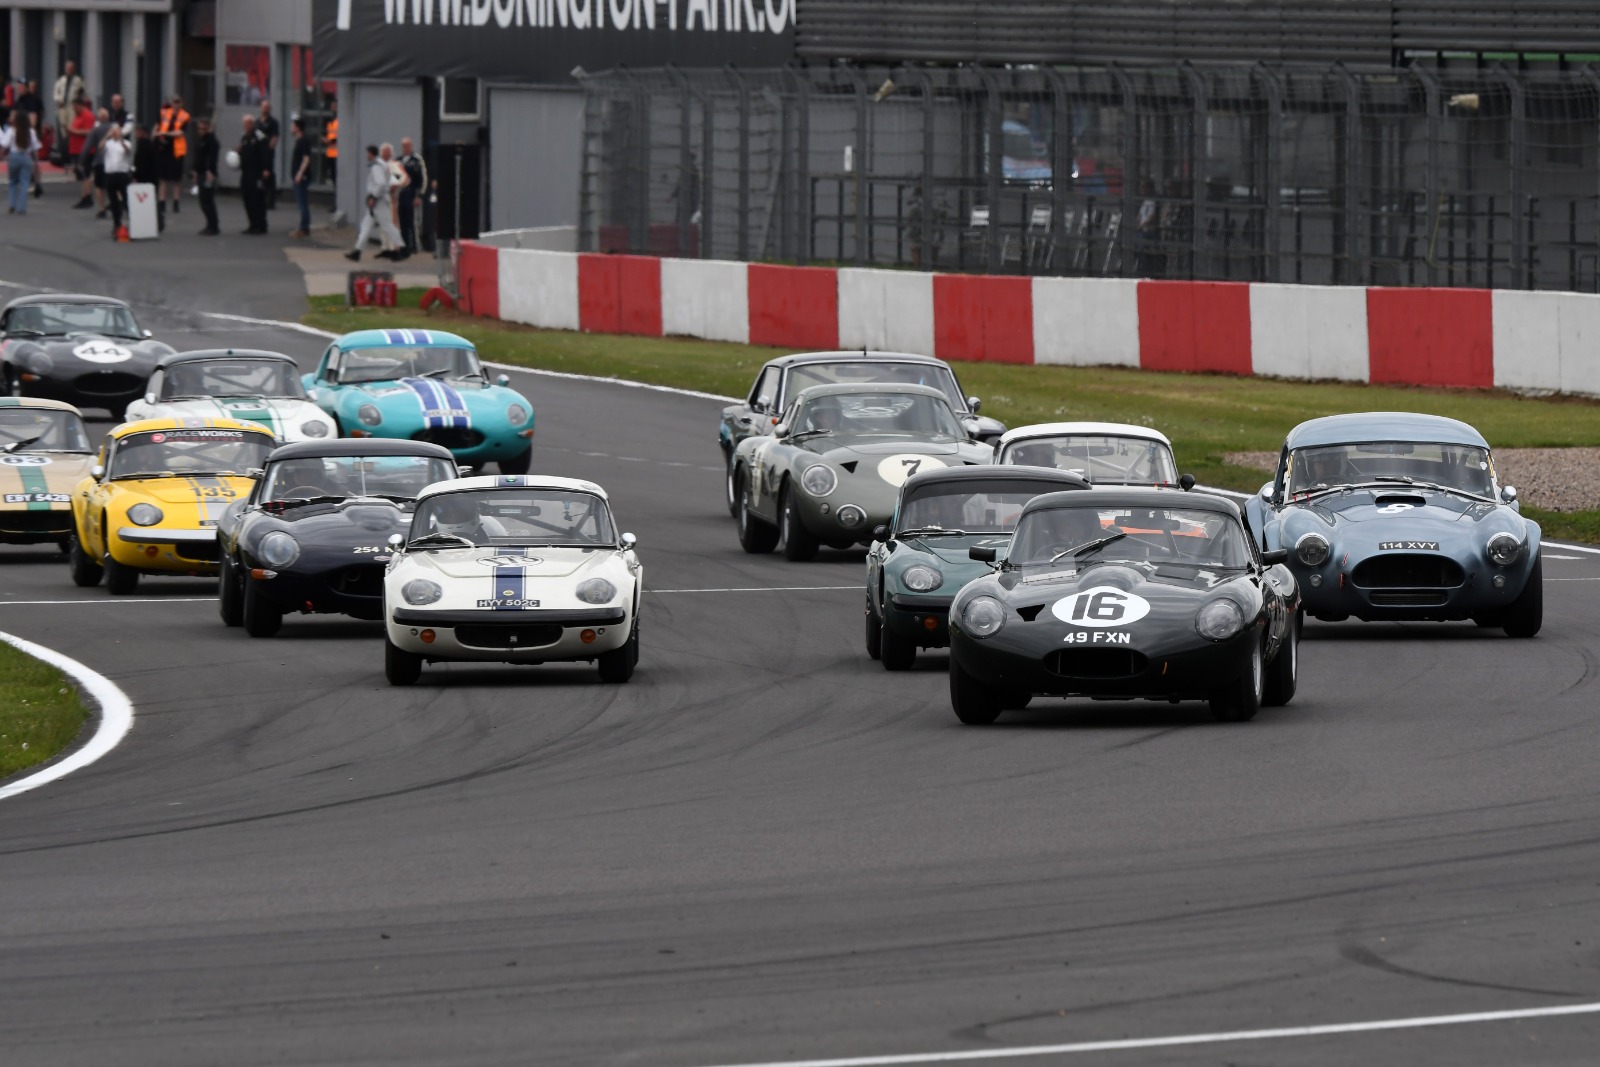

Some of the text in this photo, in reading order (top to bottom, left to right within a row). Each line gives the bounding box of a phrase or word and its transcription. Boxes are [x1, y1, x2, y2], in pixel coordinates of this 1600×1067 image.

[81, 346, 125, 356] 44
[165, 430, 243, 438] RACEWORKS
[3, 456, 47, 464] 63
[902, 459, 921, 478] 7
[189, 486, 236, 497] 135
[1376, 503, 1415, 514] 8
[353, 546, 380, 554] 254
[1381, 542, 1437, 550] 114 XVY
[505, 599, 538, 607] 502C
[1071, 591, 1128, 620] 16
[1063, 632, 1131, 644] 49 FXN
